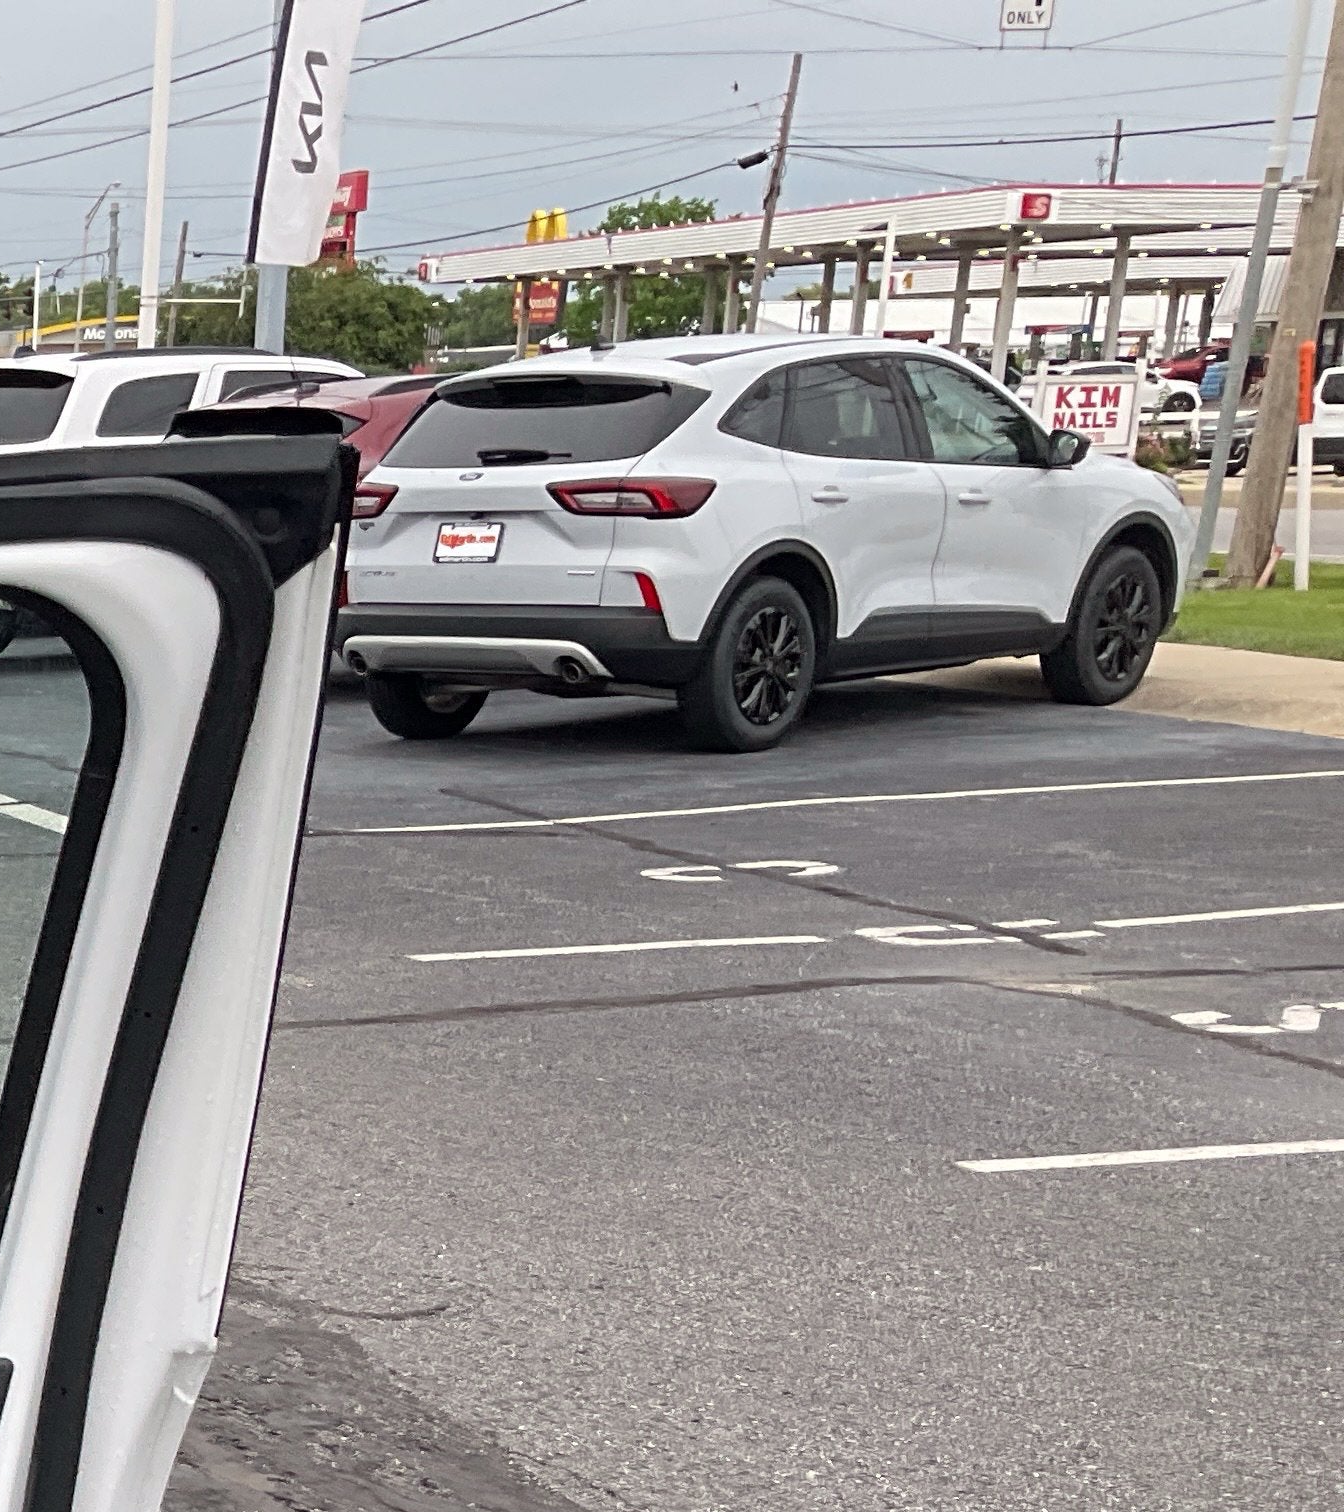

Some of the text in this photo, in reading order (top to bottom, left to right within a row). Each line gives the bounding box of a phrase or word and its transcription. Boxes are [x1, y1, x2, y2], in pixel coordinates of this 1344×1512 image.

[1007, 10, 1045, 25] ONLY
[1055, 385, 1122, 409] KIM
[1052, 411, 1118, 429] NAILS
